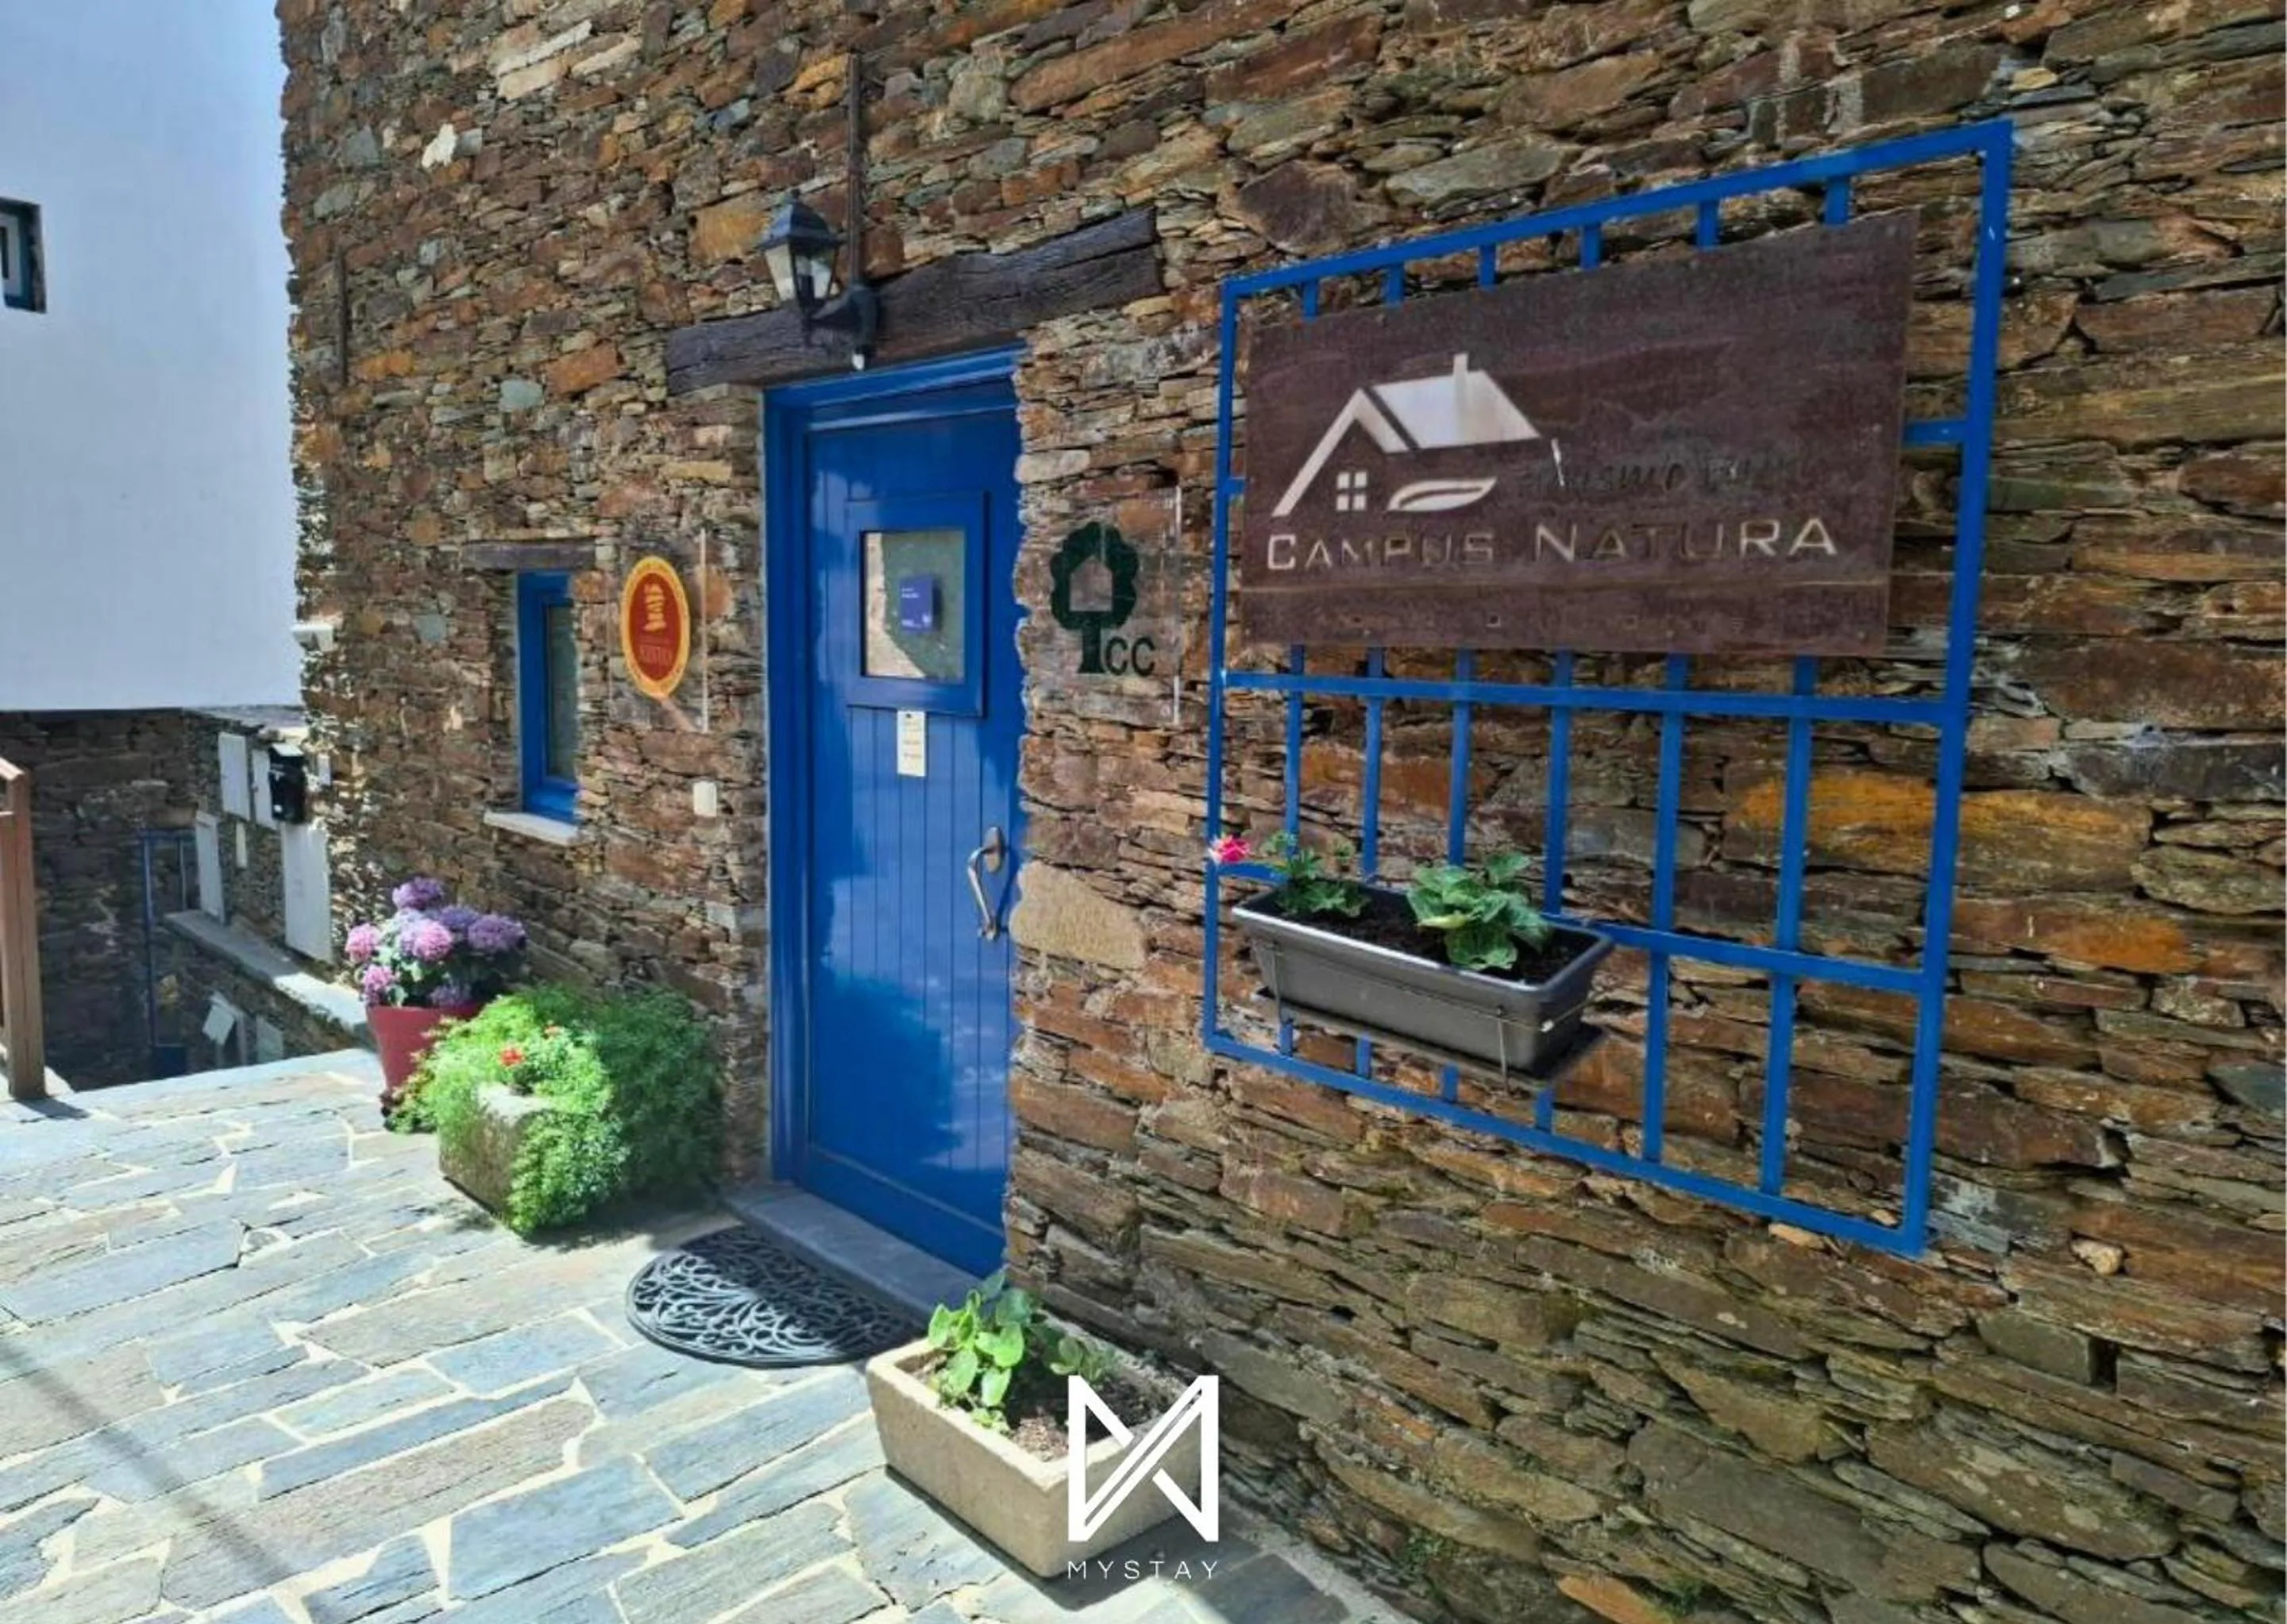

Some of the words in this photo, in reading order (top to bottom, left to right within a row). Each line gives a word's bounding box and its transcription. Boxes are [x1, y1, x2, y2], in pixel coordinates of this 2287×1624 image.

[1267, 531, 1494, 570] CAMPUS
[1535, 518, 1838, 563] NATURA
[1105, 637, 1155, 676] CC
